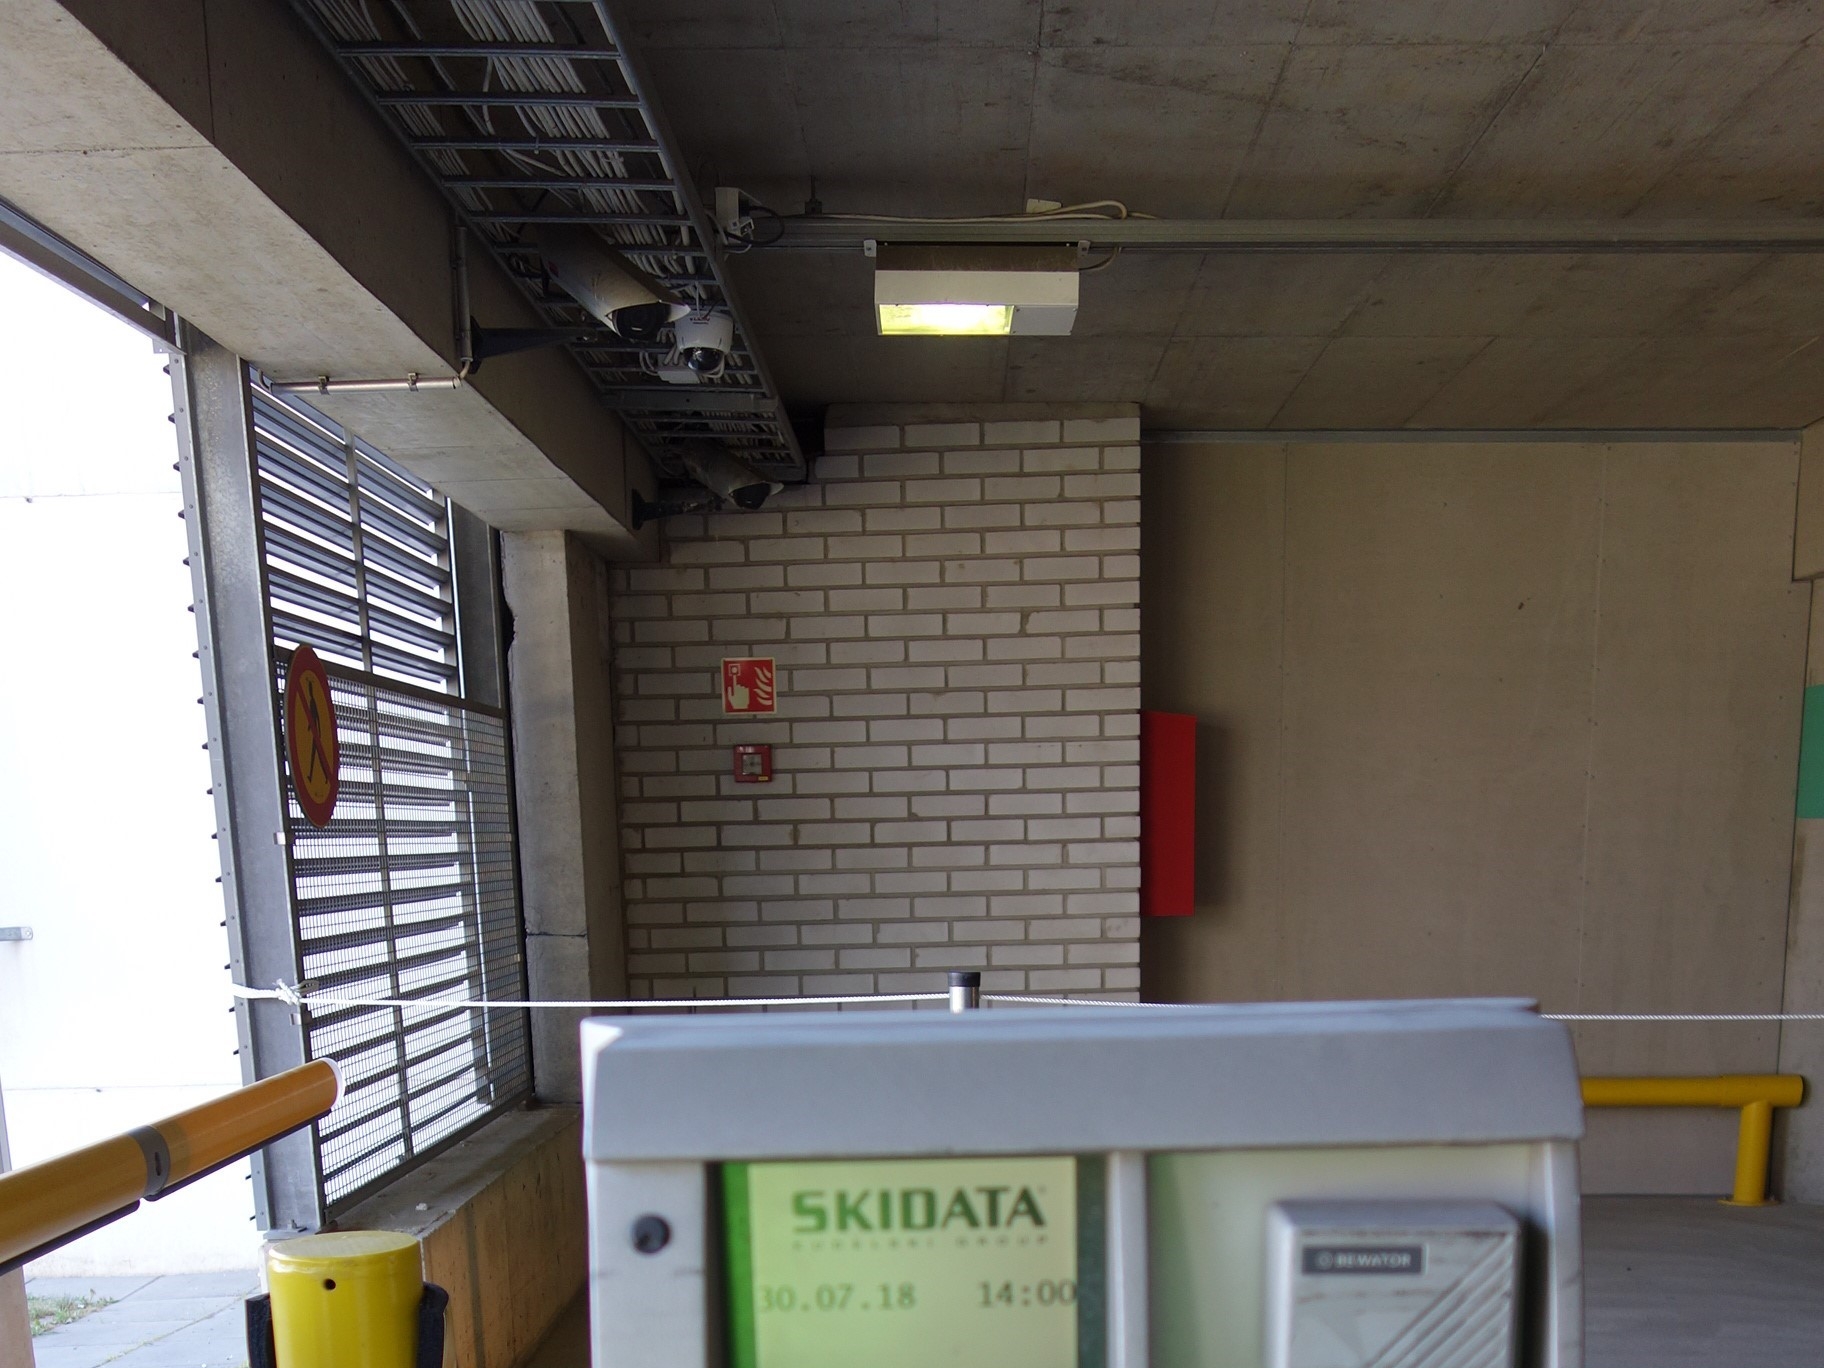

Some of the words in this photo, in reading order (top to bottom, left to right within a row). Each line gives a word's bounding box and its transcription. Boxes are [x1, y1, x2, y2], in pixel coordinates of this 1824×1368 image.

[793, 1187, 1045, 1232] SKIDATA
[759, 1285, 916, 1314] 30.07.18
[979, 1281, 1077, 1307] 14:00
